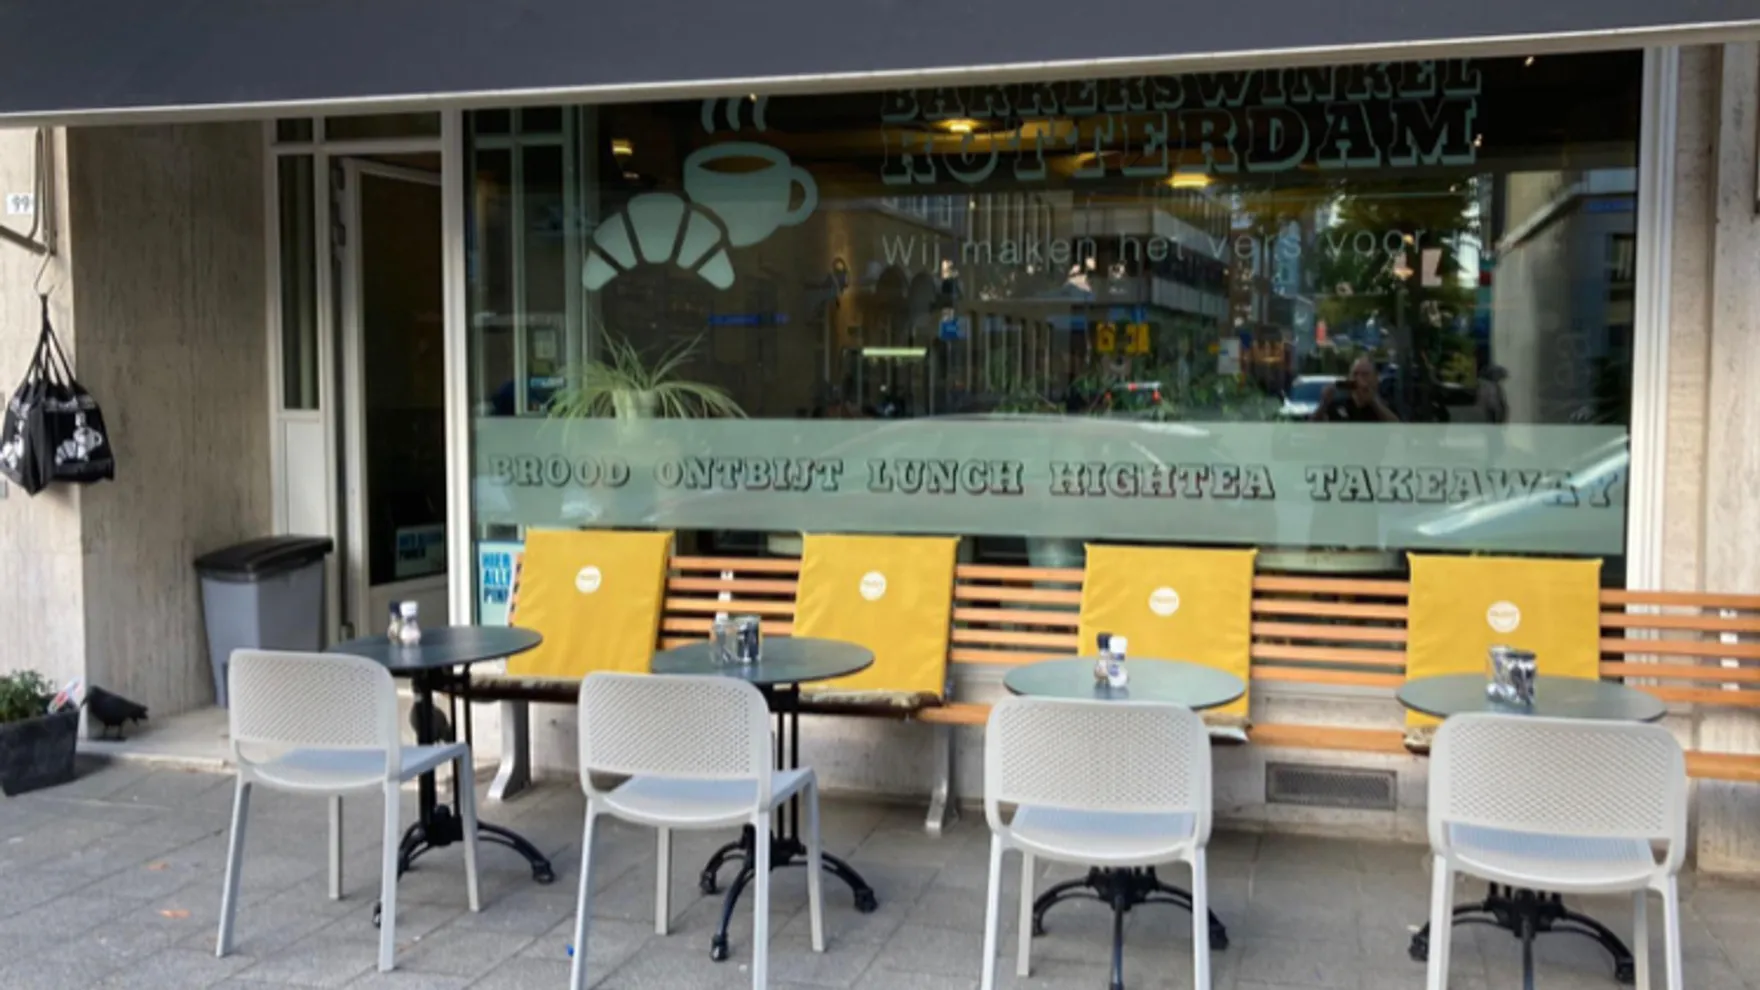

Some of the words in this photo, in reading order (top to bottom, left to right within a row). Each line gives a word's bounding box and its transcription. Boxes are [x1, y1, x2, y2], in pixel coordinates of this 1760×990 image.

[881, 98, 1478, 185] ROTTERDAM
[882, 234, 941, 275] Wij
[961, 232, 1098, 265] maken
[1119, 230, 1186, 261] het
[1208, 232, 1302, 262] vers
[1325, 229, 1427, 257] voor
[488, 454, 631, 489] BROOD
[653, 456, 844, 492] ONTBIJT
[867, 459, 1024, 496] LUNCH
[1048, 460, 1276, 500] HIGHTEA
[1304, 463, 1626, 509] TAKEAWAY
